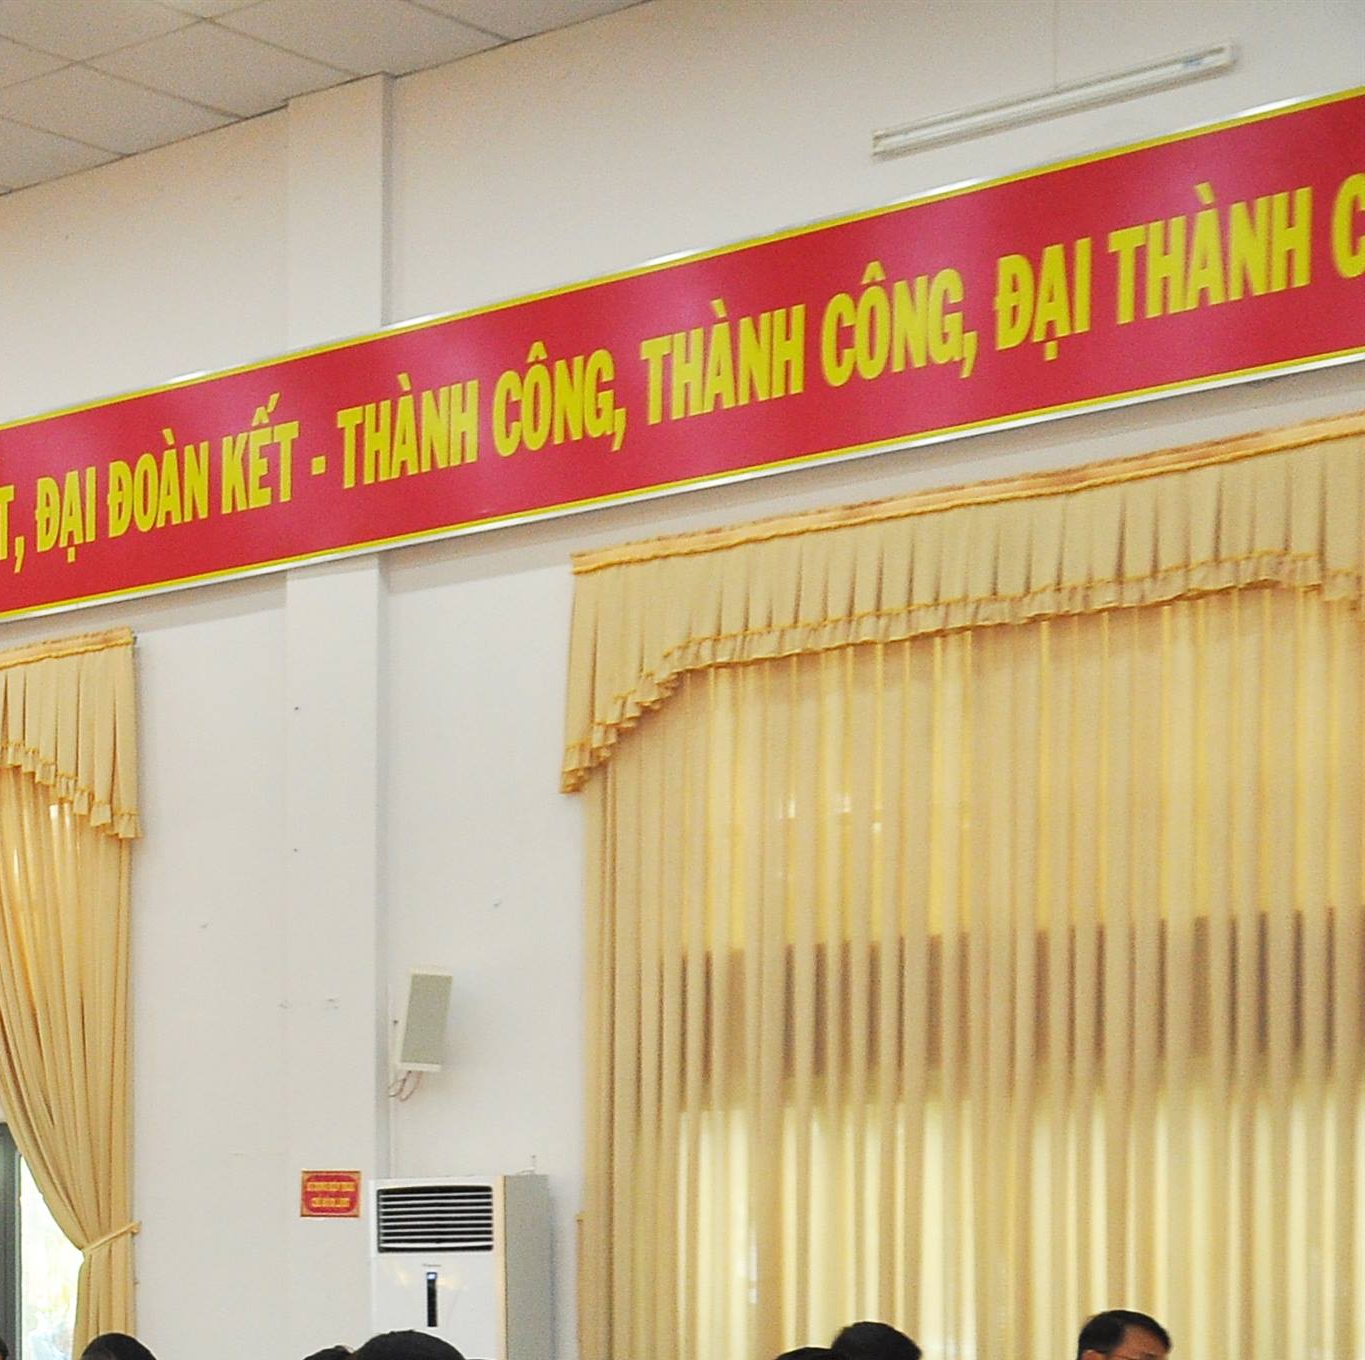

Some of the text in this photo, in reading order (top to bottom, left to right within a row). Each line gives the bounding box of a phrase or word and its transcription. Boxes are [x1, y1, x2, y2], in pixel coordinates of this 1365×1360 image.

[34, 466, 98, 564] ĐẠI
[106, 427, 211, 538] ĐOÀN
[220, 393, 300, 515] KẾT
[311, 455, 327, 476] -
[336, 372, 480, 489] THÀNH
[492, 340, 627, 457] CÔNG,
[640, 298, 806, 425] THÀNH
[820, 260, 980, 387] CÔNG,
[993, 237, 1093, 361] ĐẠI
[1108, 181, 1314, 325] THÀNH
